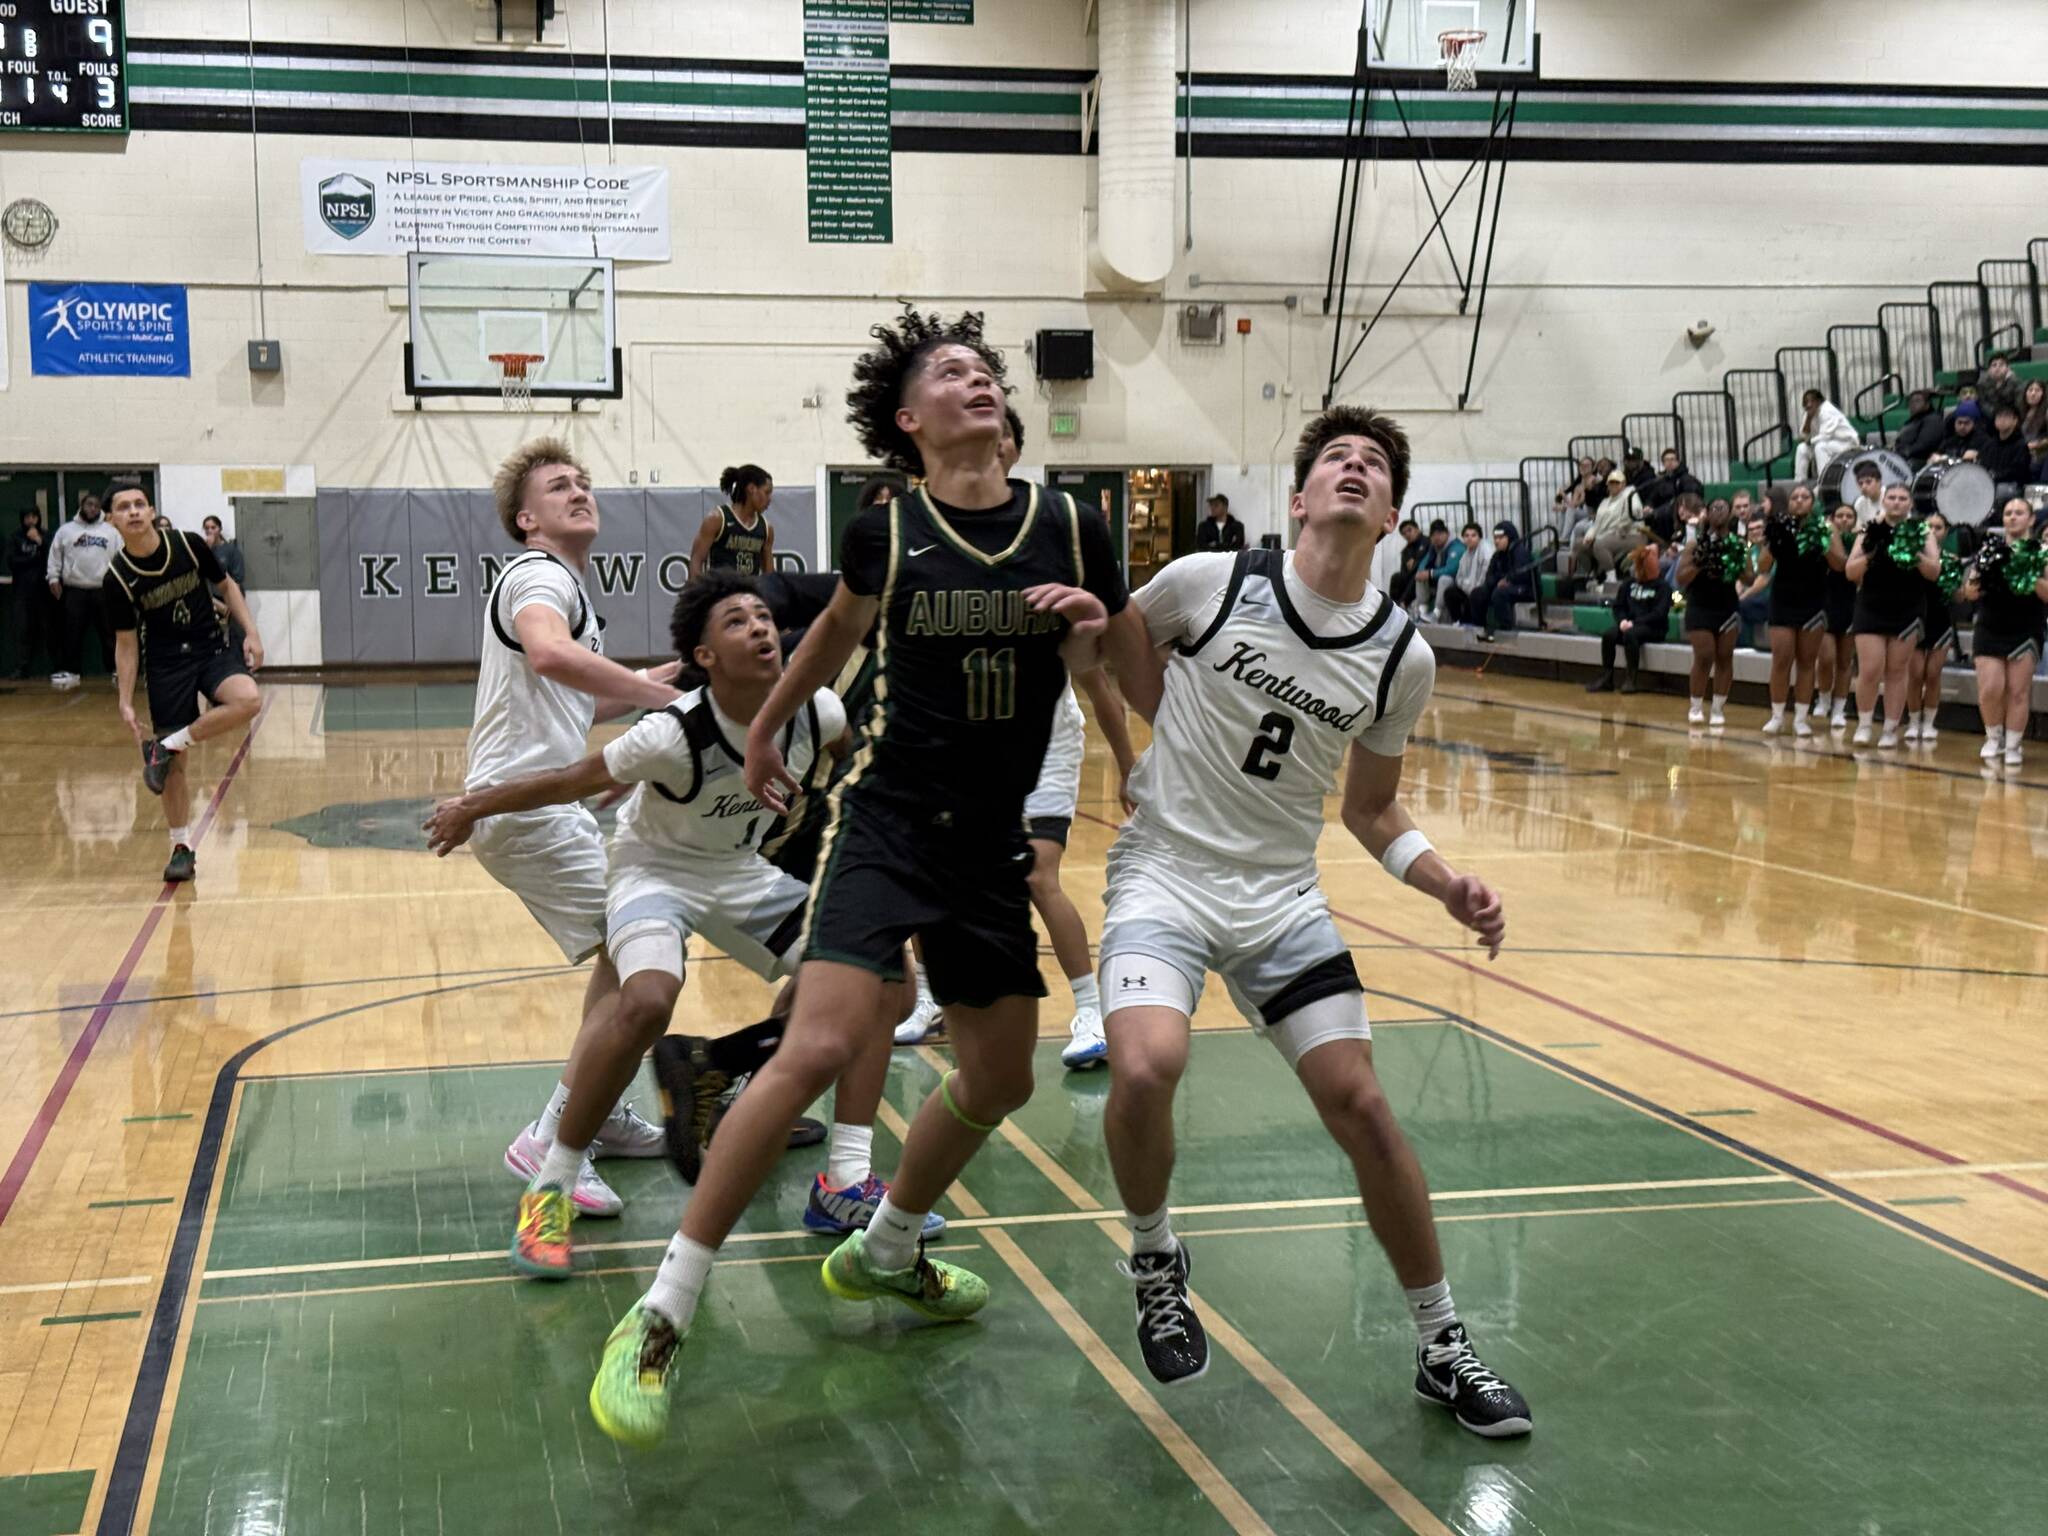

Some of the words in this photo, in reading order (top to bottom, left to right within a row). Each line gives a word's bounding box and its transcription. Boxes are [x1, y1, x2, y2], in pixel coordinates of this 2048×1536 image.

[51, 0, 110, 15] GUEST
[88, 19, 113, 57] 9
[8, 61, 39, 74] FOUL
[79, 62, 119, 77] FOULS
[27, 77, 35, 104] 1
[51, 84, 68, 104] 4
[97, 77, 116, 109] 3
[82, 114, 122, 128] SCORE
[387, 172, 437, 186] NPSL
[394, 193, 401, 202] A
[326, 203, 370, 218] NPSL
[76, 302, 172, 321] OLYMPIC
[78, 320, 123, 331] SPORTS
[127, 321, 135, 332] &
[139, 321, 173, 333] SPINE
[78, 353, 125, 363] ATHLETIC
[127, 353, 174, 364] TRAINING
[962, 648, 1016, 720] 11
[1213, 642, 1368, 732] Kentwood
[1241, 711, 1295, 781] 2
[735, 816, 760, 849] 1
